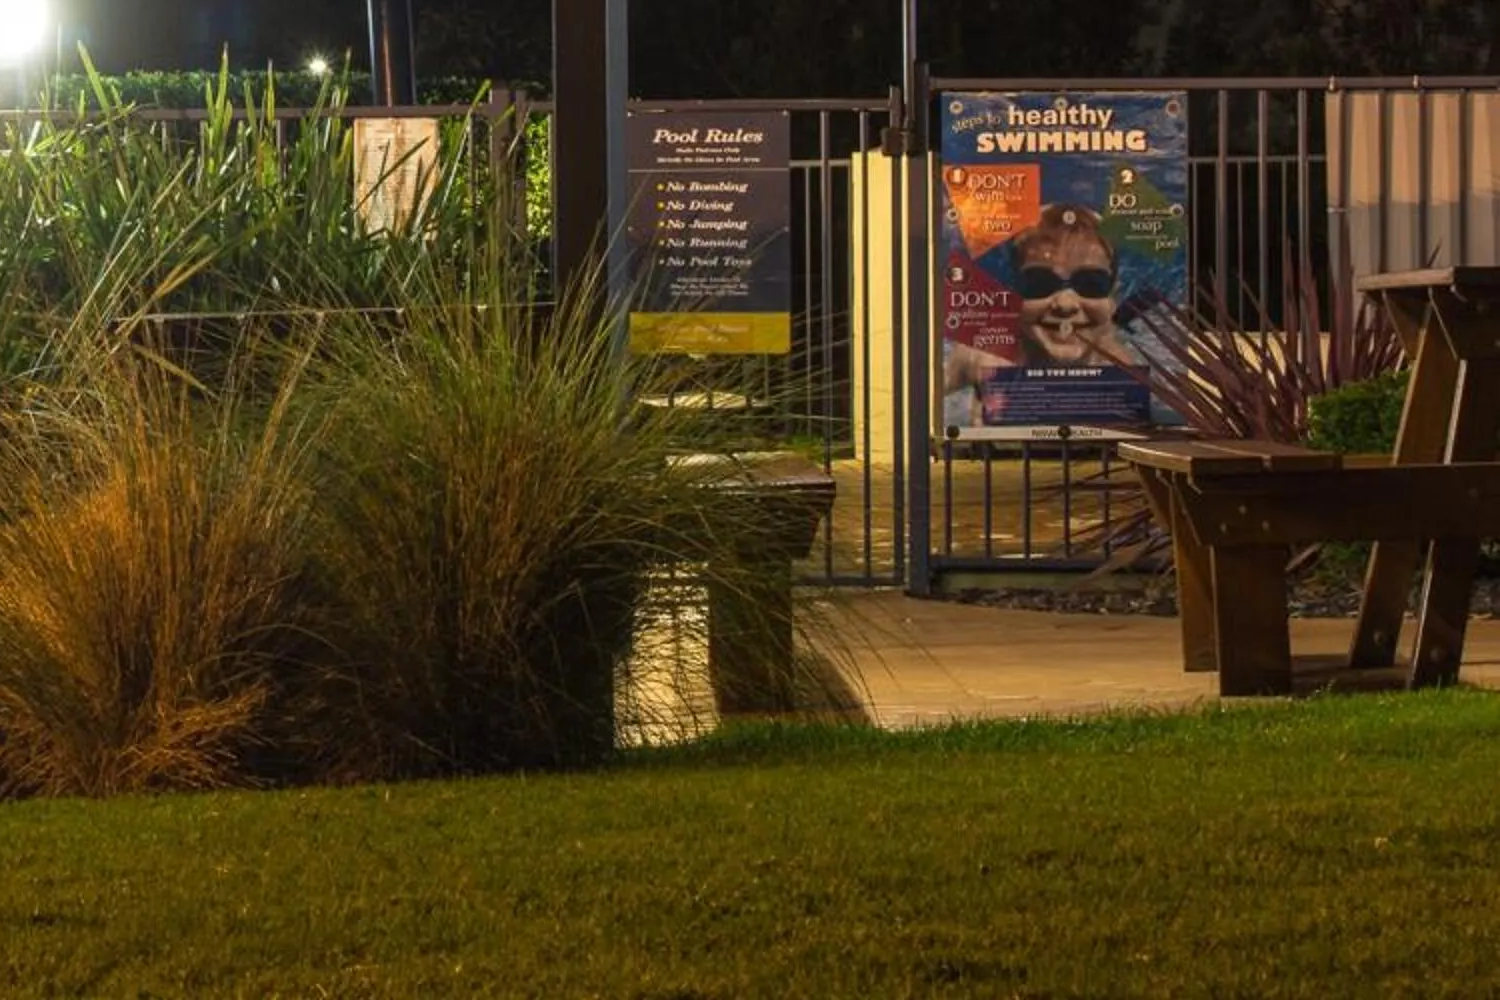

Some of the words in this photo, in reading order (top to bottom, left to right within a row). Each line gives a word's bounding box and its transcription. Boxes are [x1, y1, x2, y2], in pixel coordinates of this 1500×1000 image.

[1007, 103, 1113, 129] healthy
[653, 128, 699, 144] Pool
[704, 128, 764, 144] Rules
[976, 130, 1147, 153] SWIMMING
[966, 172, 1026, 189] DON'T
[1121, 169, 1133, 184] 2
[665, 181, 685, 192] No
[689, 181, 749, 193] Bombing
[665, 200, 685, 211] No
[689, 199, 734, 212] Diving
[1109, 193, 1137, 208] DO
[666, 219, 685, 230] No
[688, 219, 748, 231] Jumping
[666, 238, 685, 249] No
[689, 237, 748, 249] Running
[666, 256, 685, 267] No
[689, 255, 720, 267] Pool
[951, 267, 964, 281] 3
[950, 291, 1010, 308] DON'T
